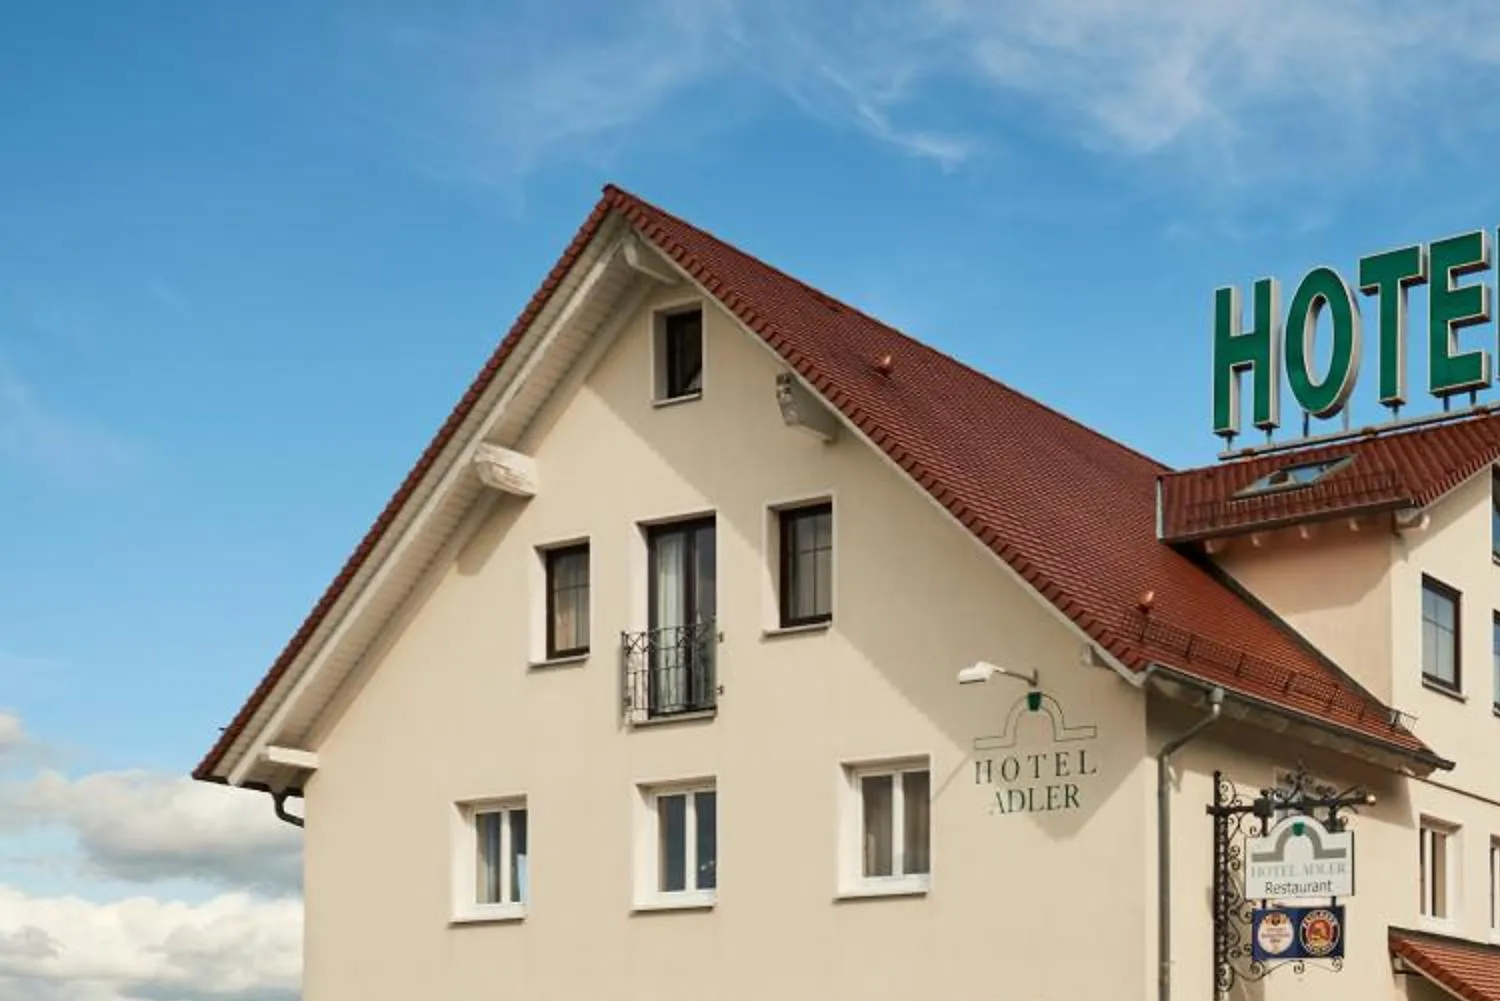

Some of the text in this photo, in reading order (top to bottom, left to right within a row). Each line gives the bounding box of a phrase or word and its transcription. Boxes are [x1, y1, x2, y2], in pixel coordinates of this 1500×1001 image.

[975, 749, 1097, 785] HOTEL
[989, 783, 1080, 815] ADLER
[1251, 864, 1294, 878] HOTEL
[1265, 880, 1332, 894] Restaurant
